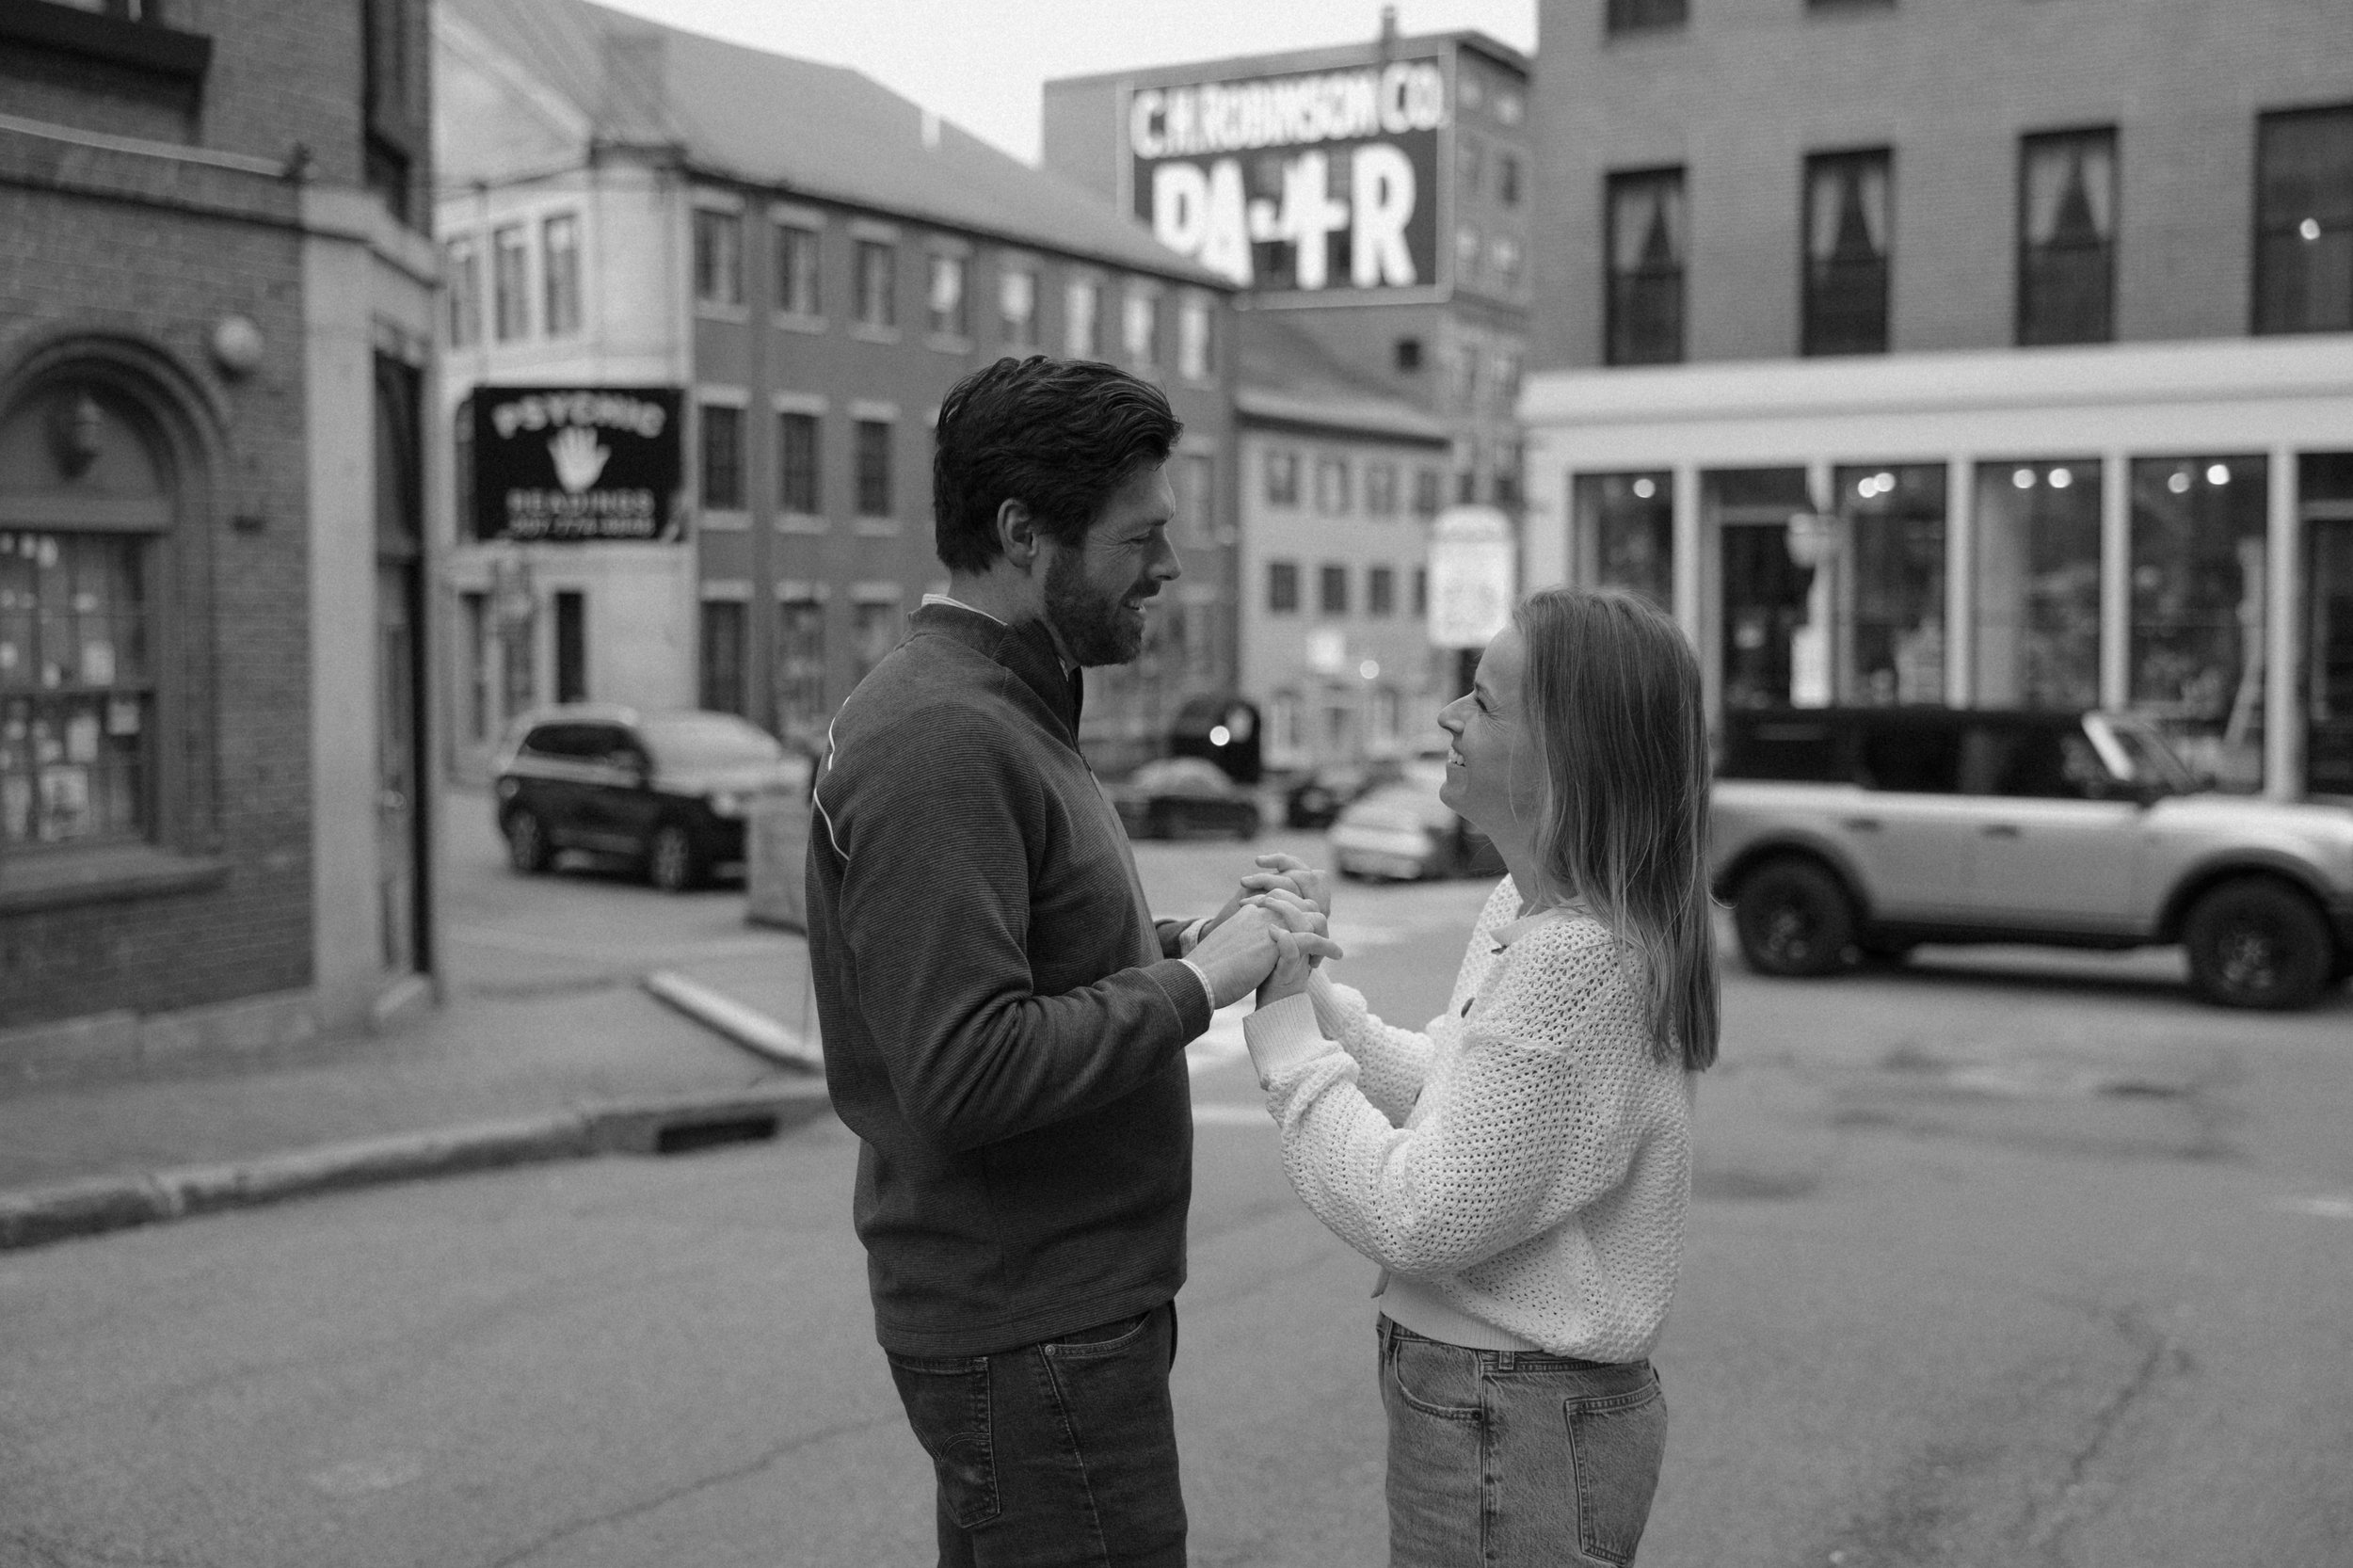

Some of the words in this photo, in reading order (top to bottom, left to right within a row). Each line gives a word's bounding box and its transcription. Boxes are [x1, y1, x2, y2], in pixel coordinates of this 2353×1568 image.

[1200, 70, 1379, 149] ROBINSON
[491, 392, 665, 439] PSYCHIC
[506, 488, 654, 516] READINGS
